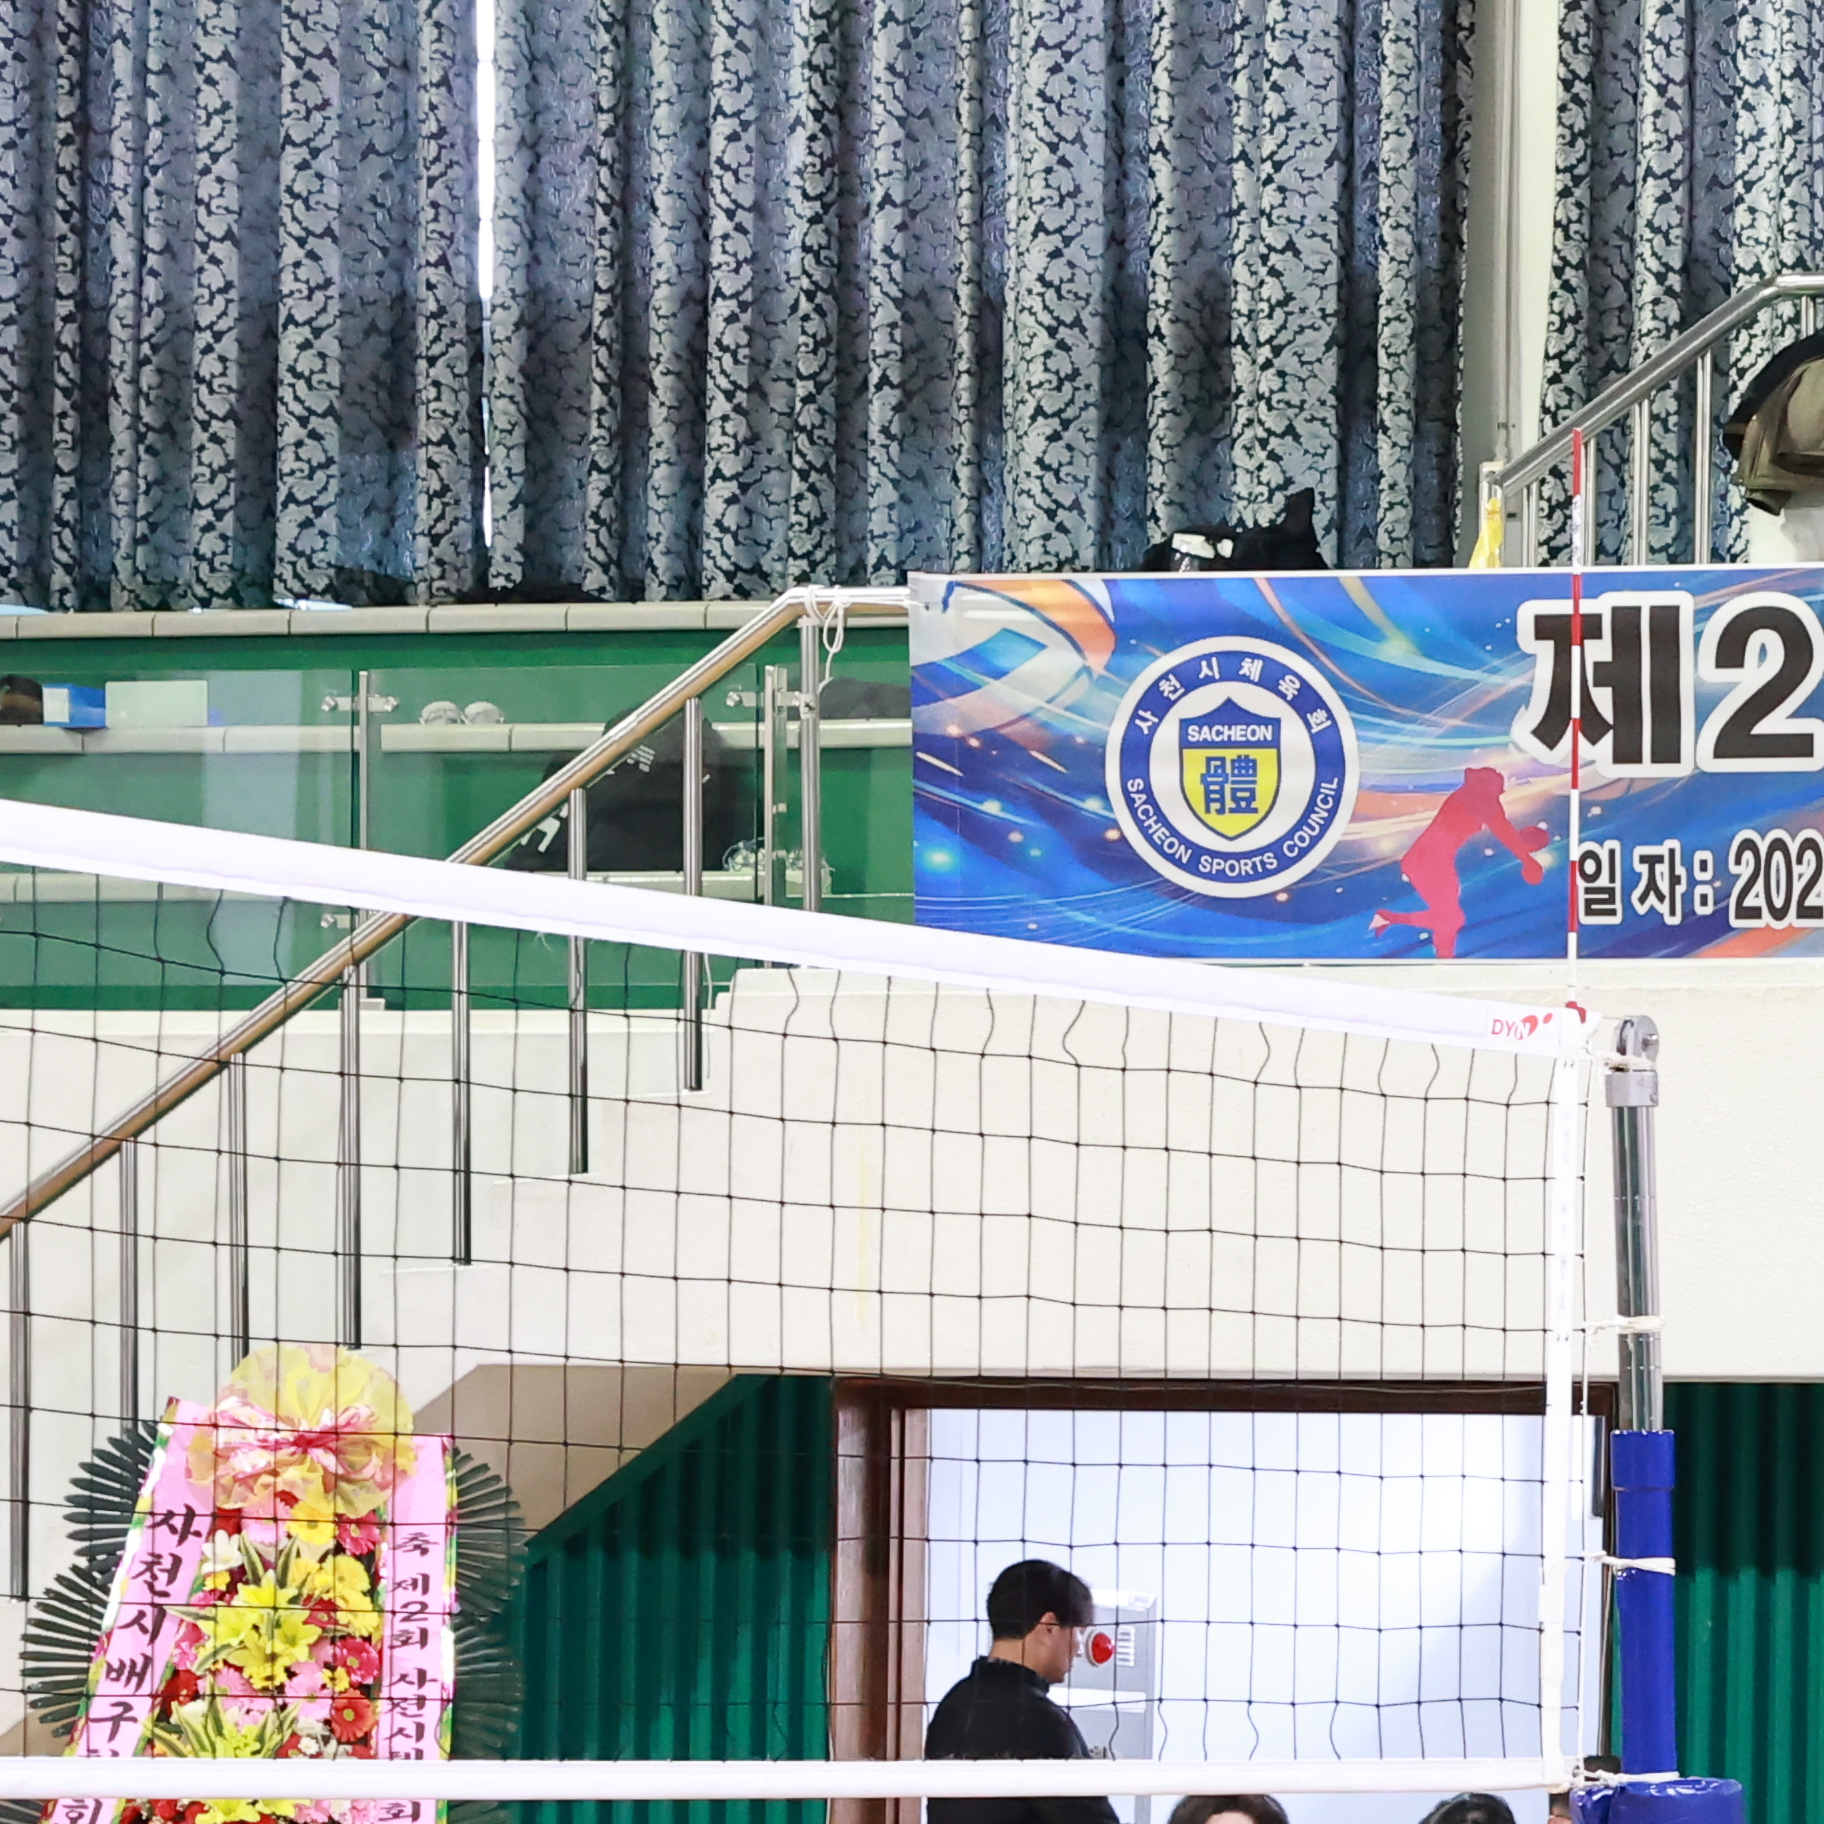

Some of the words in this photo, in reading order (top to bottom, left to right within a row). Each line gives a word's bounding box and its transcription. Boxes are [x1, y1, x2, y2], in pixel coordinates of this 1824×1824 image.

[1134, 656, 1332, 735] 사천시체육회
[1187, 724, 1273, 742] SACHEON
[1127, 777, 1192, 864] SACHEON
[1198, 852, 1278, 877] SPORTS
[1282, 776, 1339, 858] COUNCIL
[388, 1573, 430, 1651] 제2회
